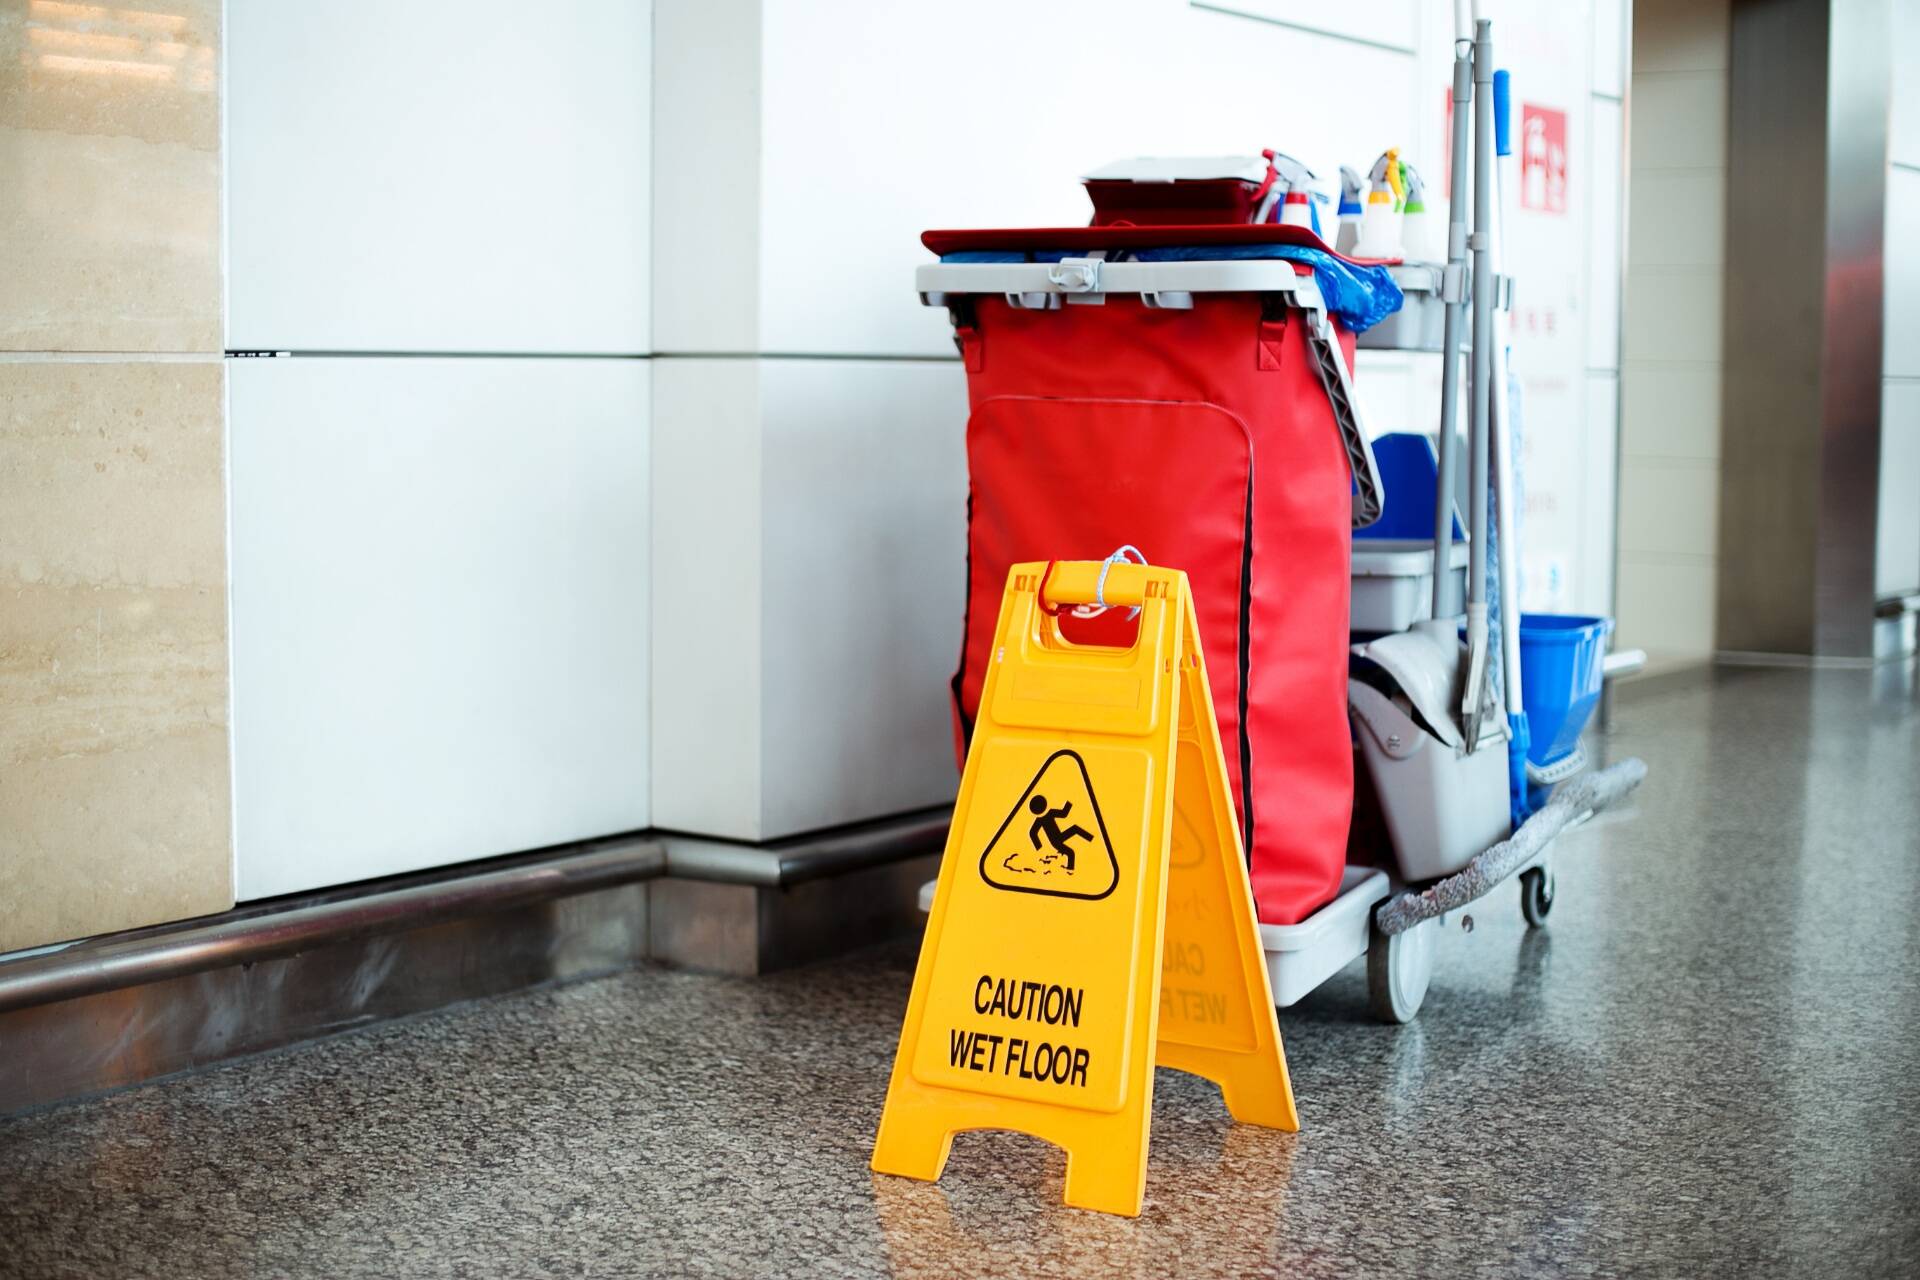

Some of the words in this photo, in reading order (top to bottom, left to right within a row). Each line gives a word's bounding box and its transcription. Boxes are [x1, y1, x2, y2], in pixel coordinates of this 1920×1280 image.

[974, 975, 1083, 1028] CAUTION
[950, 1029, 1004, 1073] WET
[1005, 1038, 1090, 1087] FLOOR
